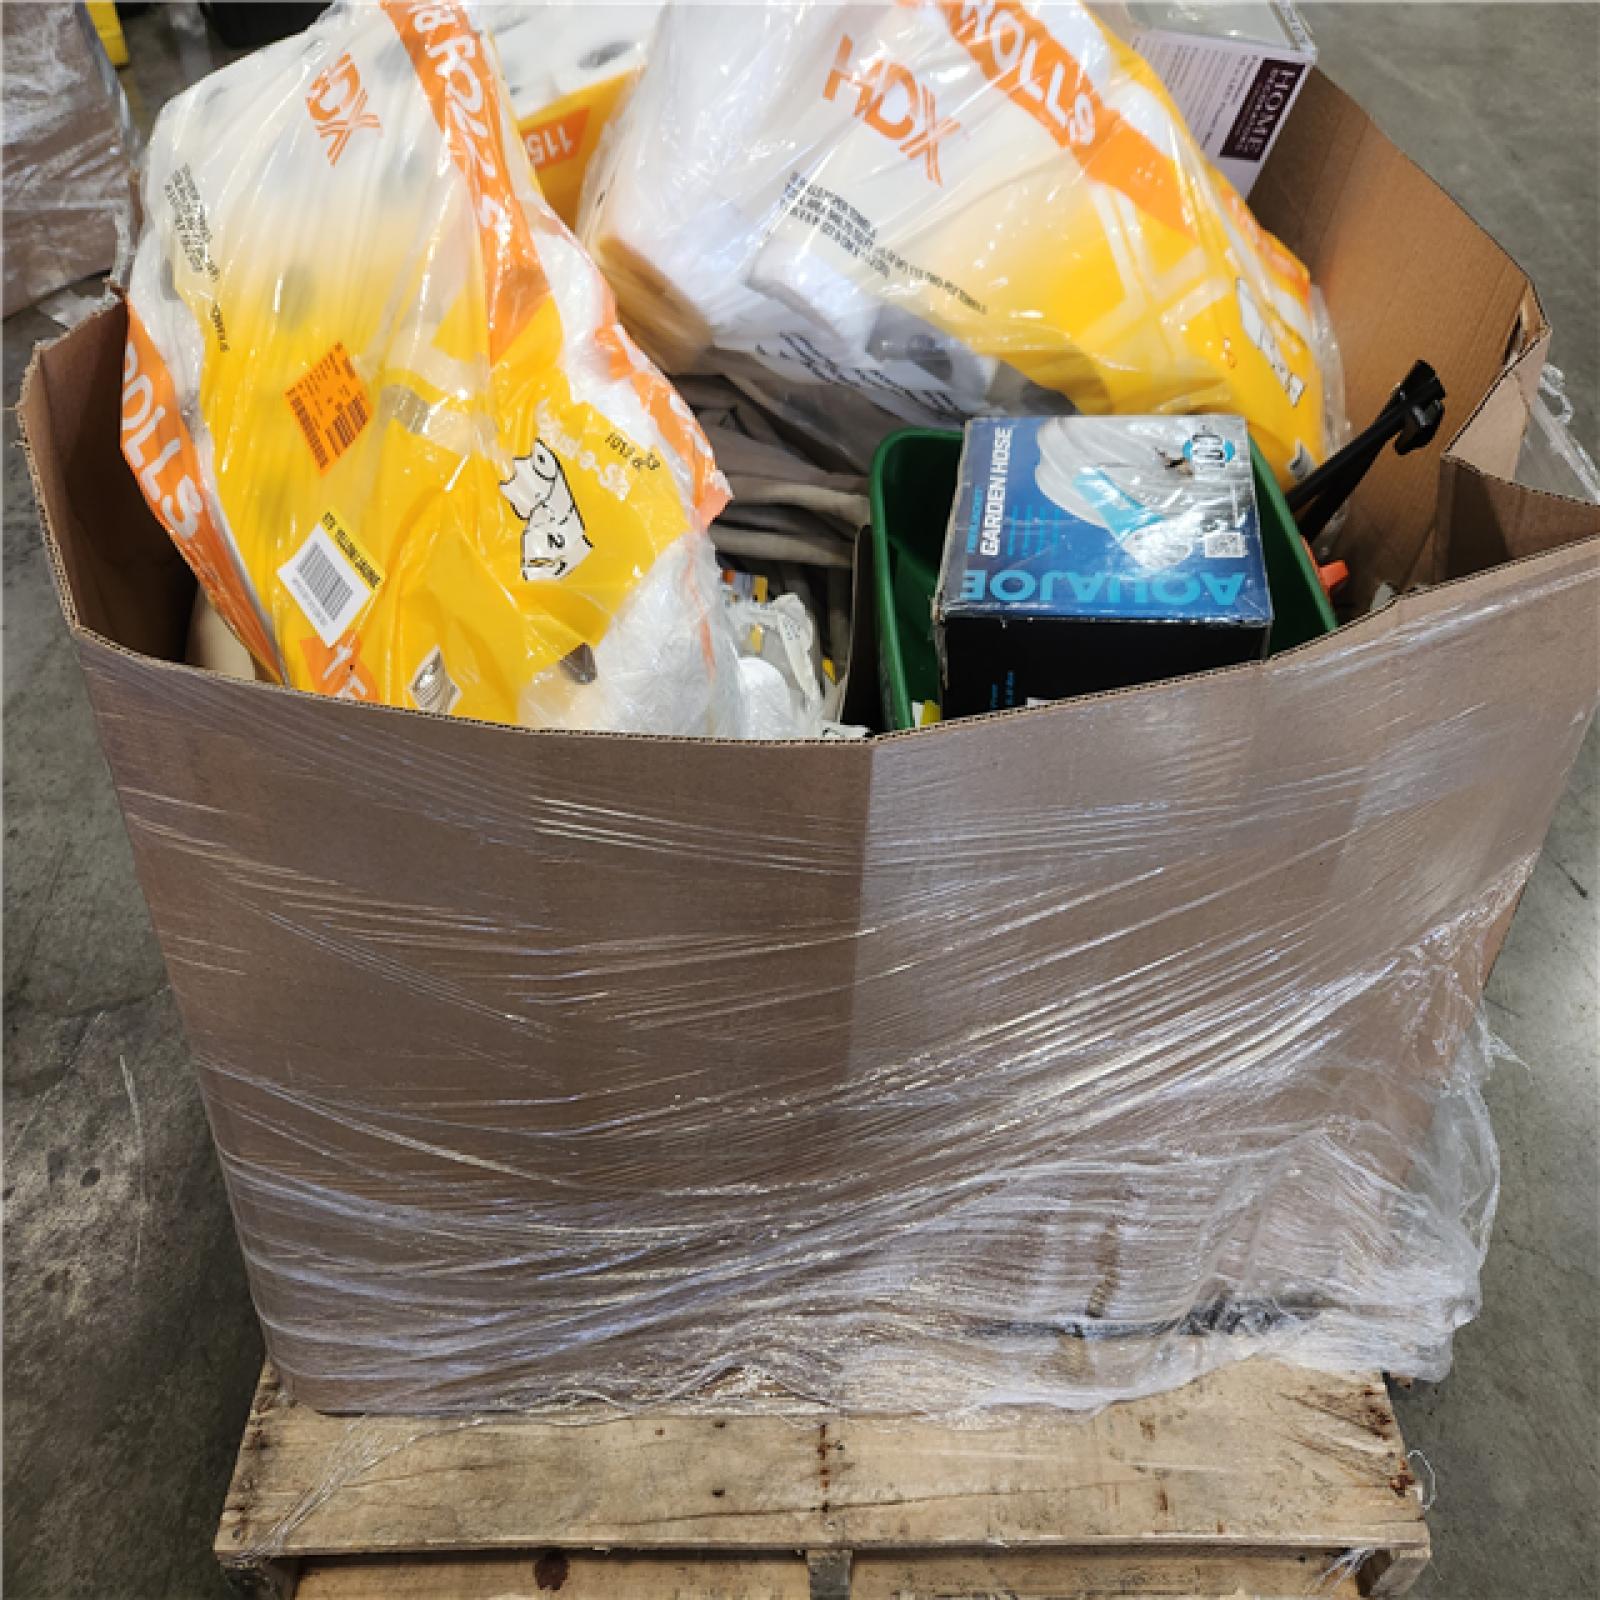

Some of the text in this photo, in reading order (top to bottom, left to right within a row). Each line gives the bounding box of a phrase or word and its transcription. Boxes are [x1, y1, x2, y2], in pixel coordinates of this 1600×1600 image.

[823, 33, 960, 188] HDX
[1248, 67, 1298, 153] HOME
[980, 427, 1014, 555] GARDEN HOSE
